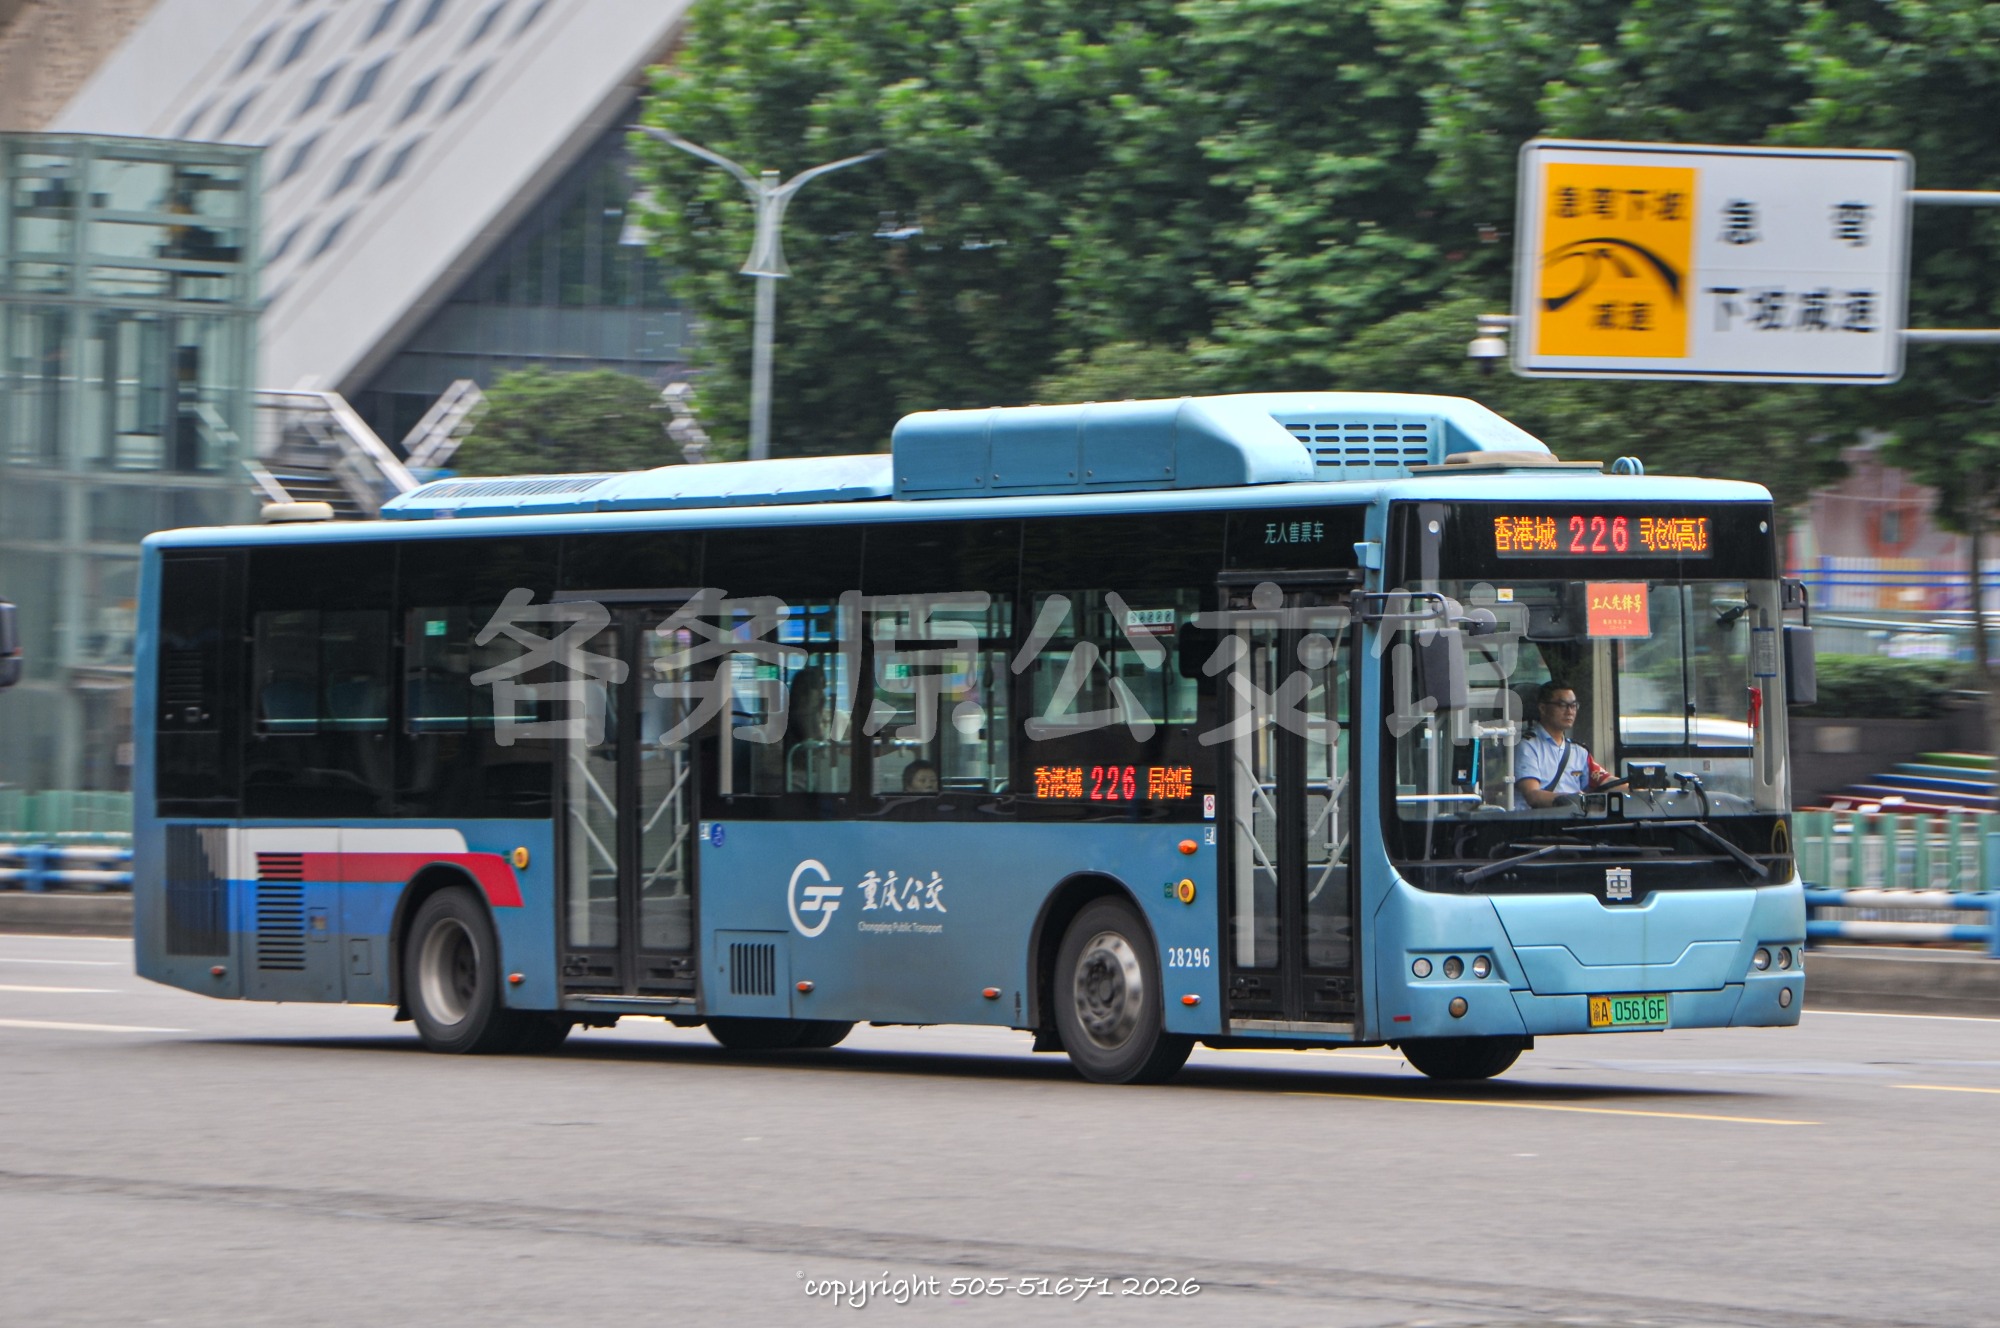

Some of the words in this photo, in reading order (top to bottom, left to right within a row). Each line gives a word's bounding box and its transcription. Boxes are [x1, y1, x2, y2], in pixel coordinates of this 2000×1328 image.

[1265, 521, 1324, 543] 无人售票车
[1495, 516, 1556, 550] 香港城
[1569, 516, 1628, 551] 226
[1591, 594, 1642, 613] 工人先锋号
[1034, 766, 1082, 797] 香港城
[1090, 766, 1136, 799] 226
[858, 871, 947, 912] 重庆公交
[1168, 947, 1210, 968] 28296
